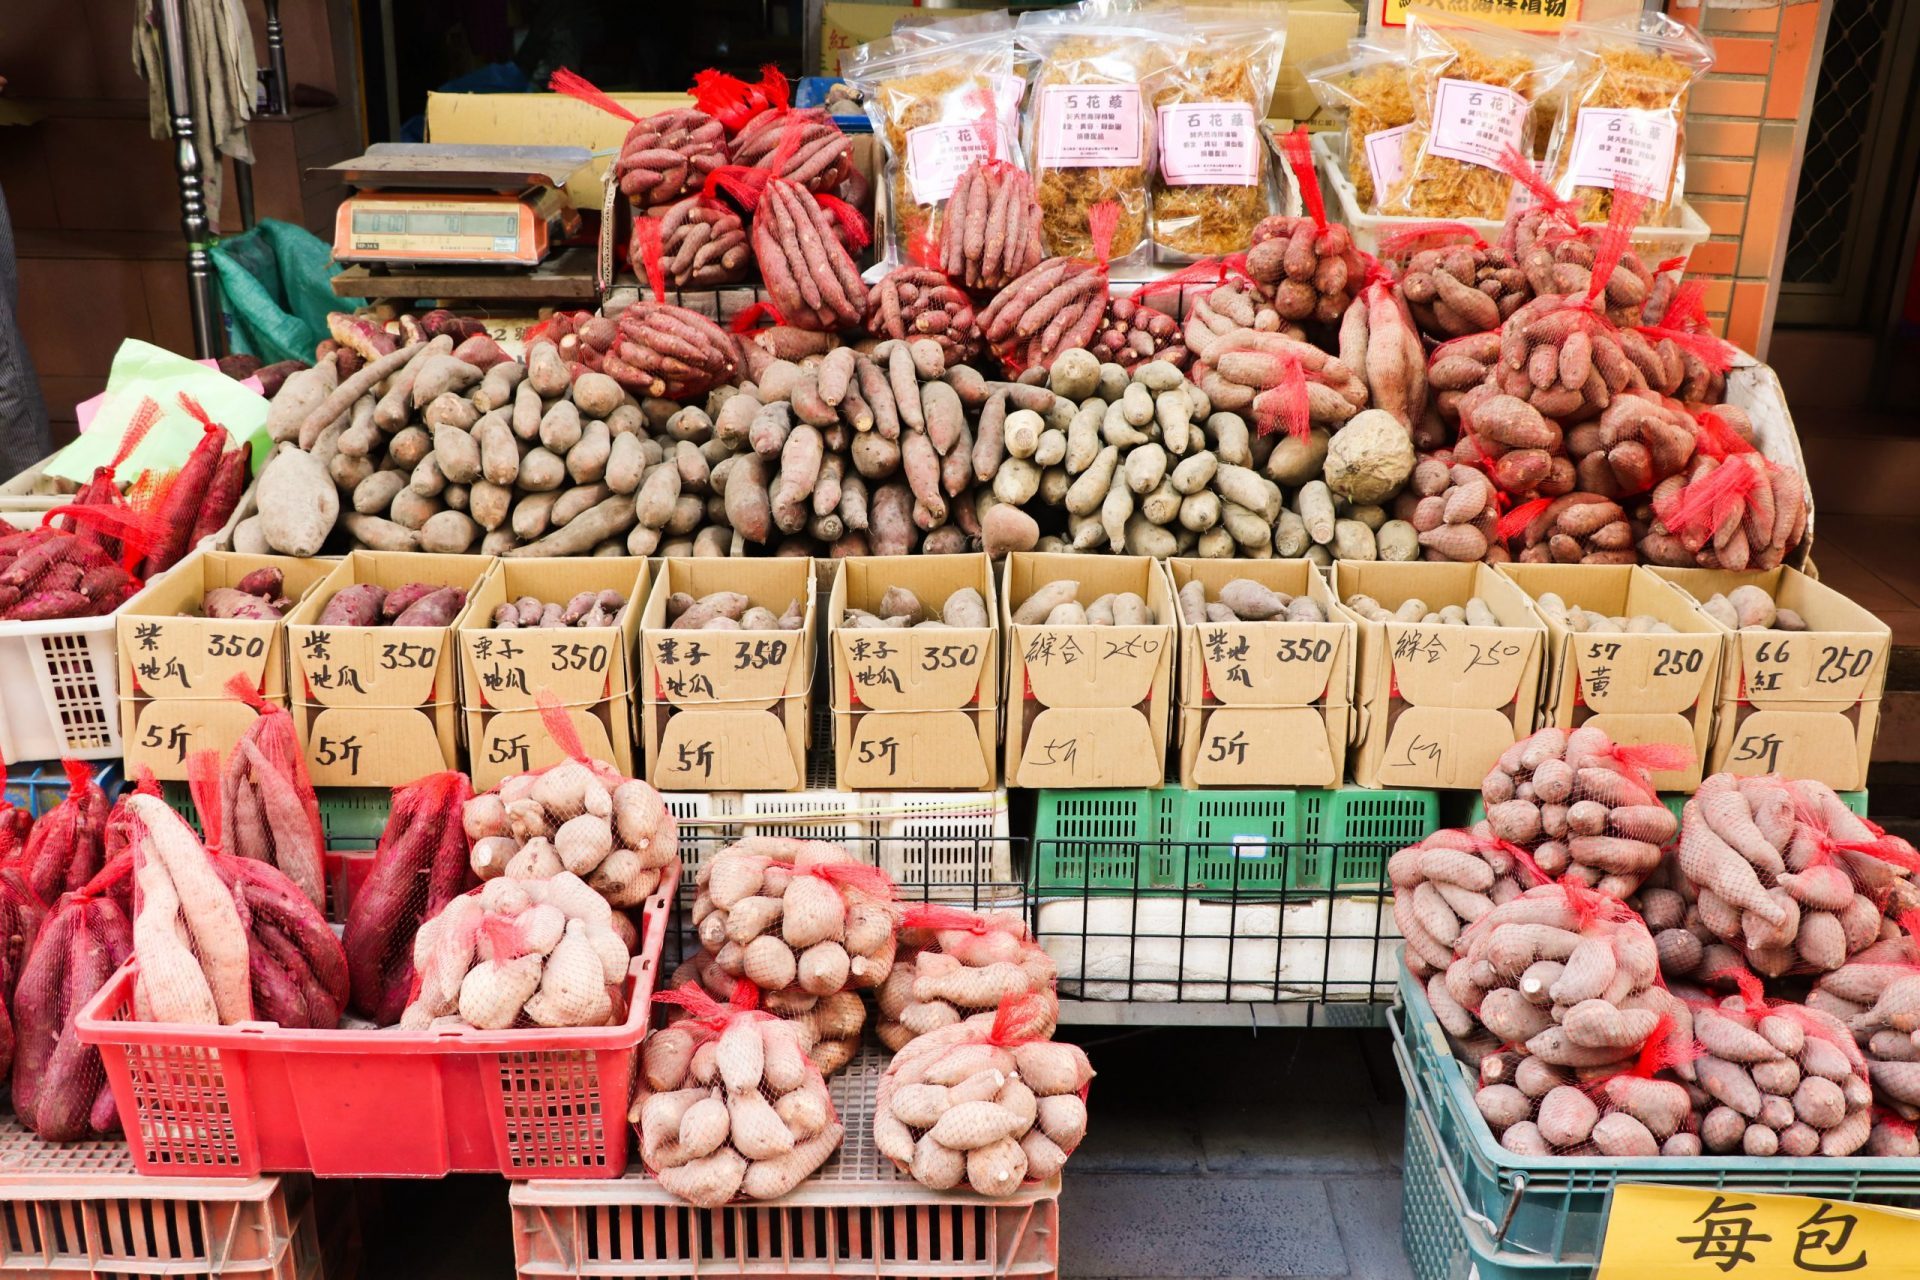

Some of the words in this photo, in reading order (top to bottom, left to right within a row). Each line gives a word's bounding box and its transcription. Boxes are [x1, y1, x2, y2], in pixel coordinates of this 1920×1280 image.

[507, 217, 517, 234] 0
[134, 623, 163, 650] 紫
[208, 635, 264, 657] 350
[302, 631, 330, 660] 紫
[380, 643, 436, 669] 350
[473, 636, 524, 660] 栗子
[552, 645, 607, 672] 350
[657, 638, 710, 665] 栗子
[734, 640, 787, 671] 350
[849, 638, 898, 661] 栗子
[922, 645, 978, 671] 350
[1025, 633, 1084, 666] 綜合
[1277, 639, 1331, 662] 350
[1395, 629, 1447, 663] 綜合
[1464, 641, 1520, 673] 250
[138, 657, 191, 688] 地瓜
[1588, 643, 1622, 660] 57
[1653, 649, 1703, 676] 250
[1756, 641, 1789, 662] 66
[1816, 646, 1873, 683] 250
[310, 665, 367, 694] 地瓜
[483, 663, 531, 695] 地瓜
[666, 670, 719, 699] 地瓜
[856, 666, 905, 693] 地瓜
[1750, 671, 1783, 693] 紅
[141, 724, 192, 764] 5斤
[316, 736, 362, 775] 5斤
[489, 734, 530, 771] 5斤
[667, 740, 714, 777] 5斤
[859, 737, 899, 775] 5斤
[1208, 731, 1250, 765] 5斤
[1734, 734, 1783, 774] 5斤
[1676, 1196, 1867, 1272] 每包
